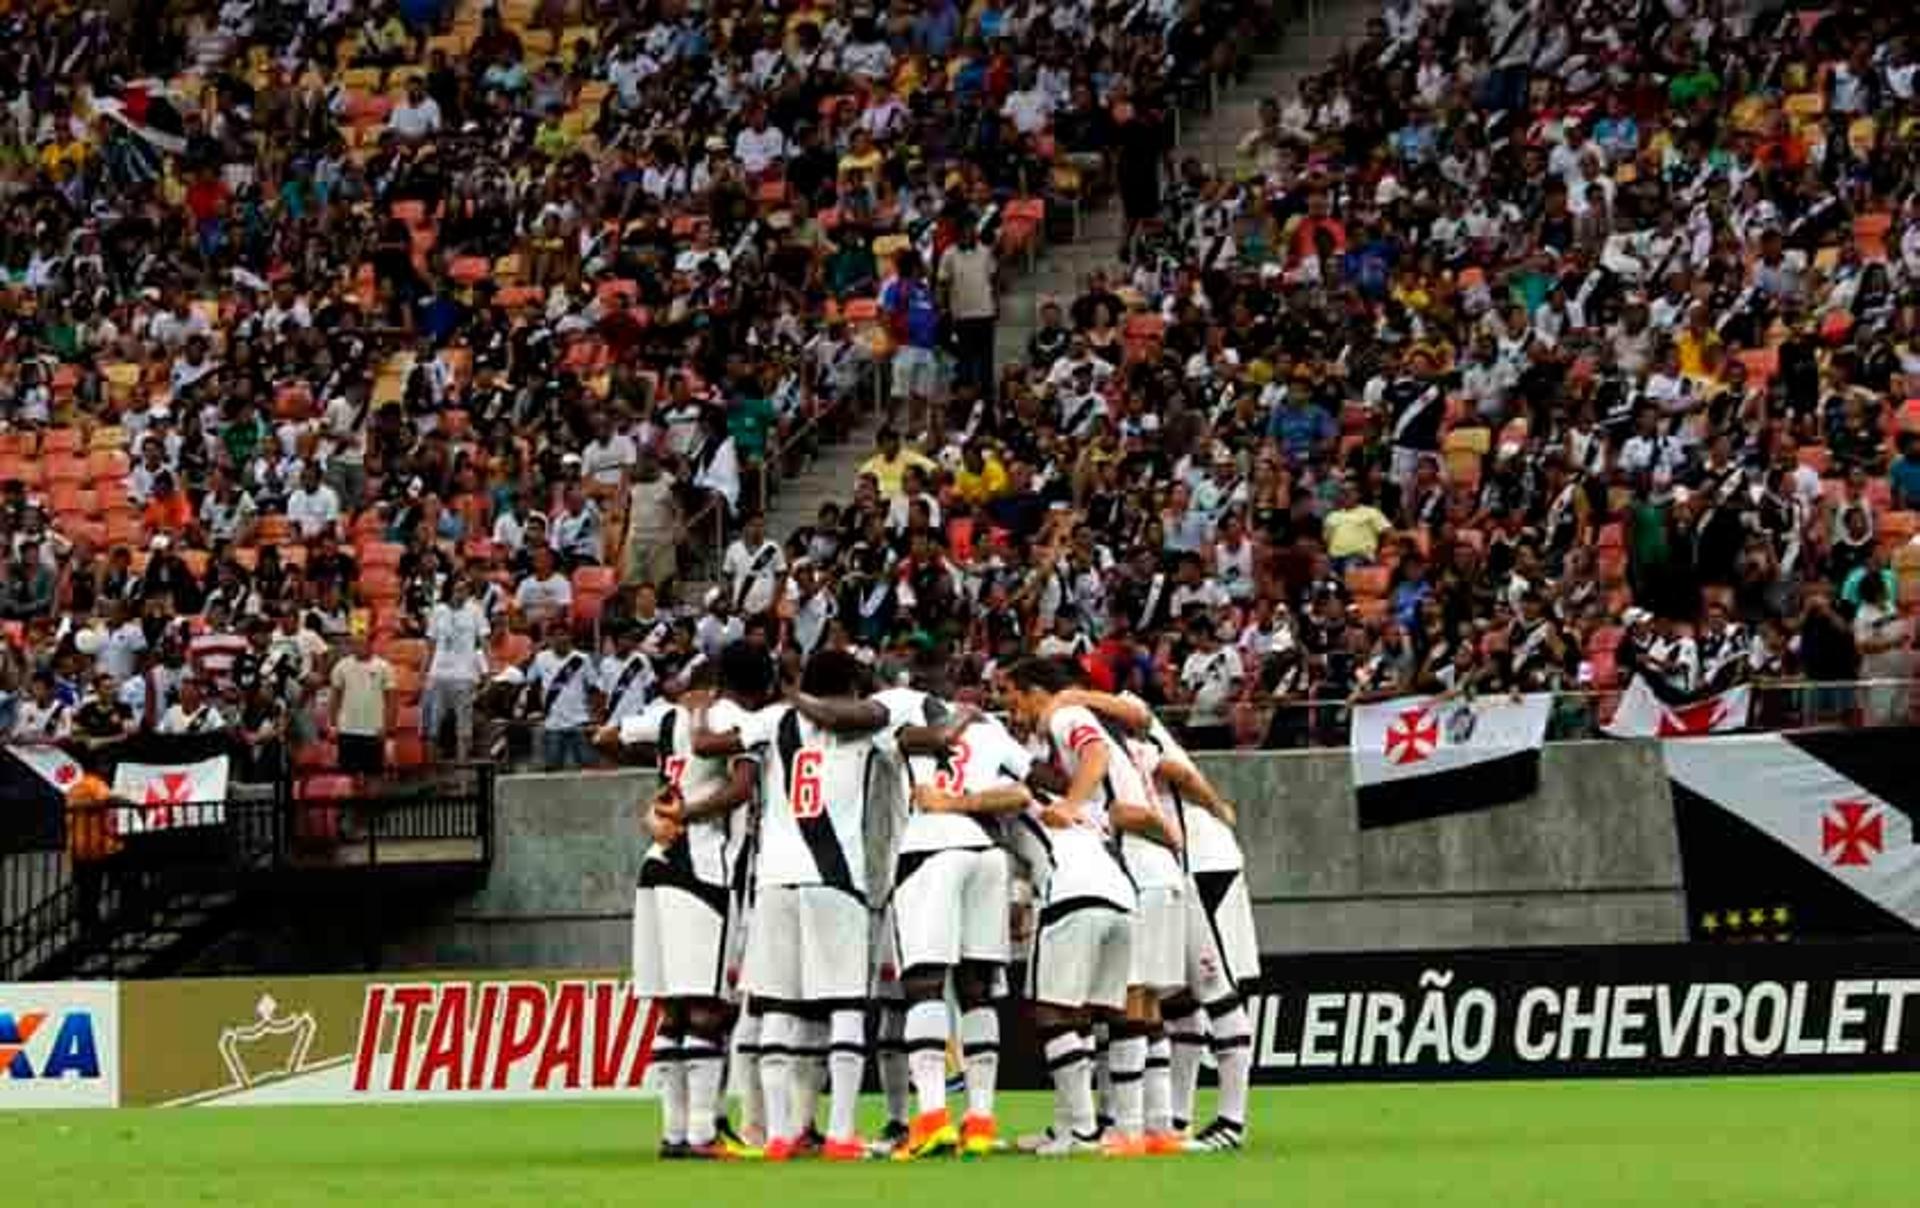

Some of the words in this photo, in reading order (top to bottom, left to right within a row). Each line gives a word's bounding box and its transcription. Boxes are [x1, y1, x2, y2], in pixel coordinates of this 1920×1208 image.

[792, 748, 825, 818] 6
[934, 737, 971, 797] 3
[1513, 978, 1920, 1061] CHEVROLET
